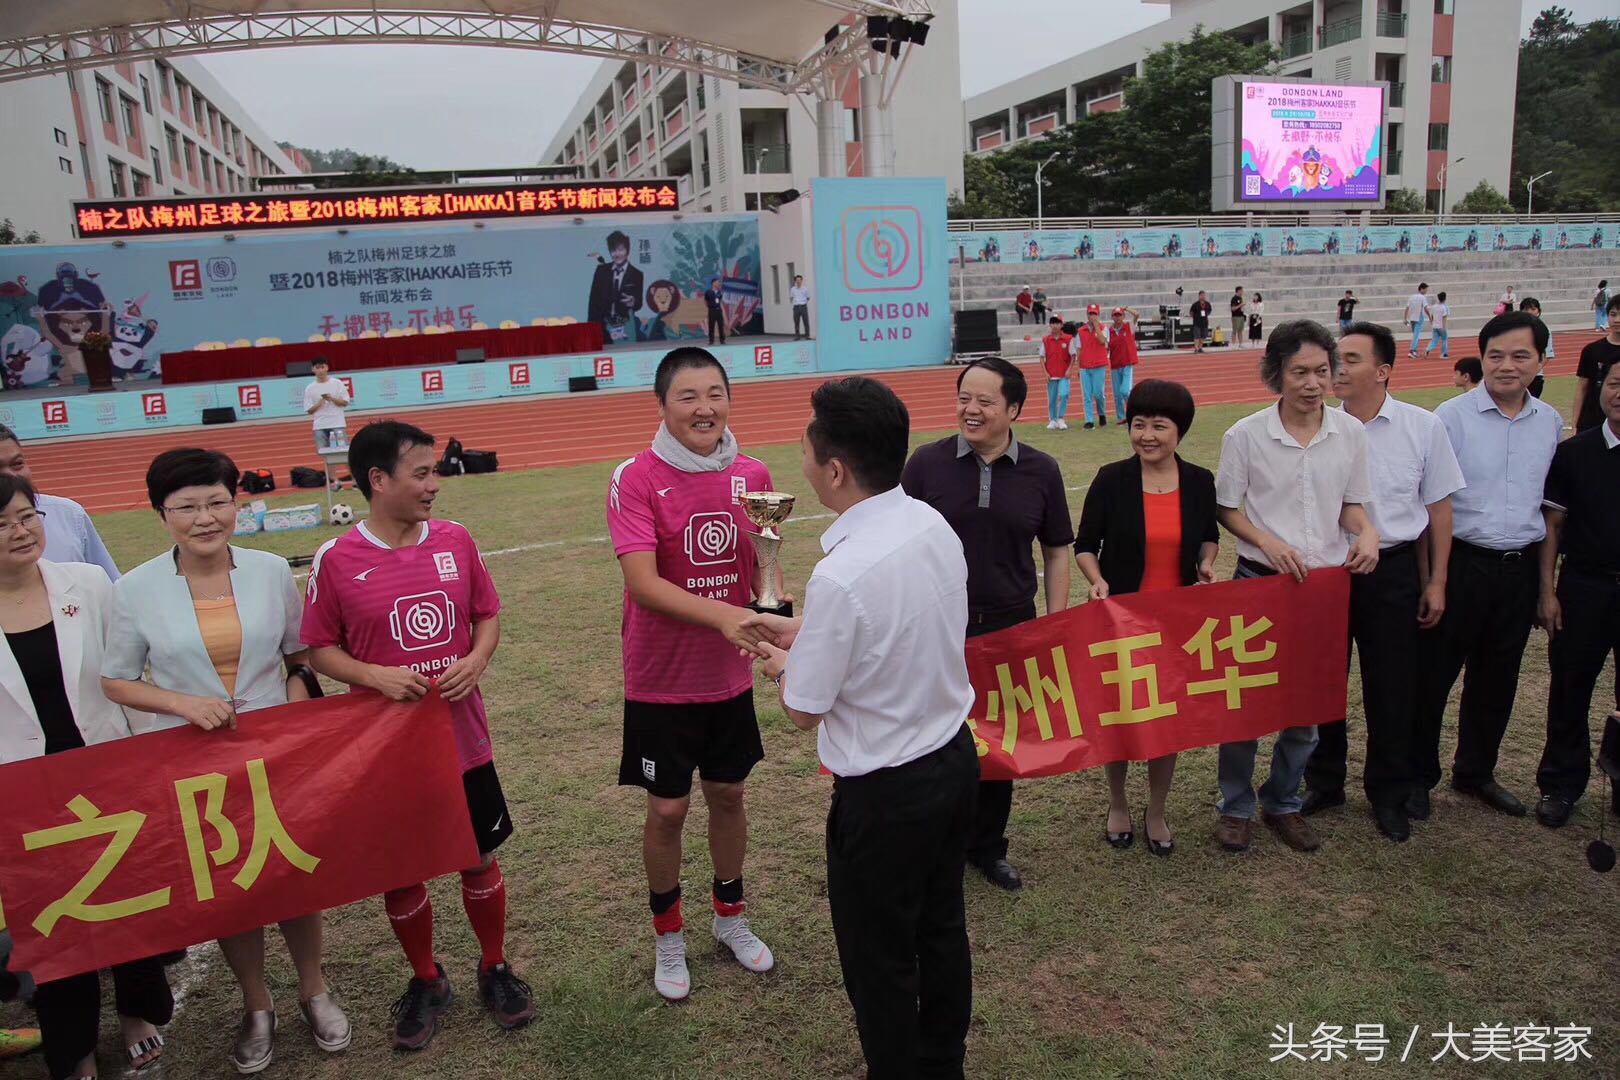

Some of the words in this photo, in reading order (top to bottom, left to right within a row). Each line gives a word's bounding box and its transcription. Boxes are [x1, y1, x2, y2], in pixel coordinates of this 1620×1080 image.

[1320, 89, 1343, 98] LAND
[328, 244, 457, 265] 楠之队梅州足球之旅
[359, 287, 433, 305] 新闻发布会
[839, 302, 930, 322] BONBON
[859, 327, 912, 342] LAND
[687, 573, 739, 588] BONBON
[400, 654, 459, 673] ONBON
[967, 614, 1279, 756] 州五华
[0, 758, 321, 937] 之队
